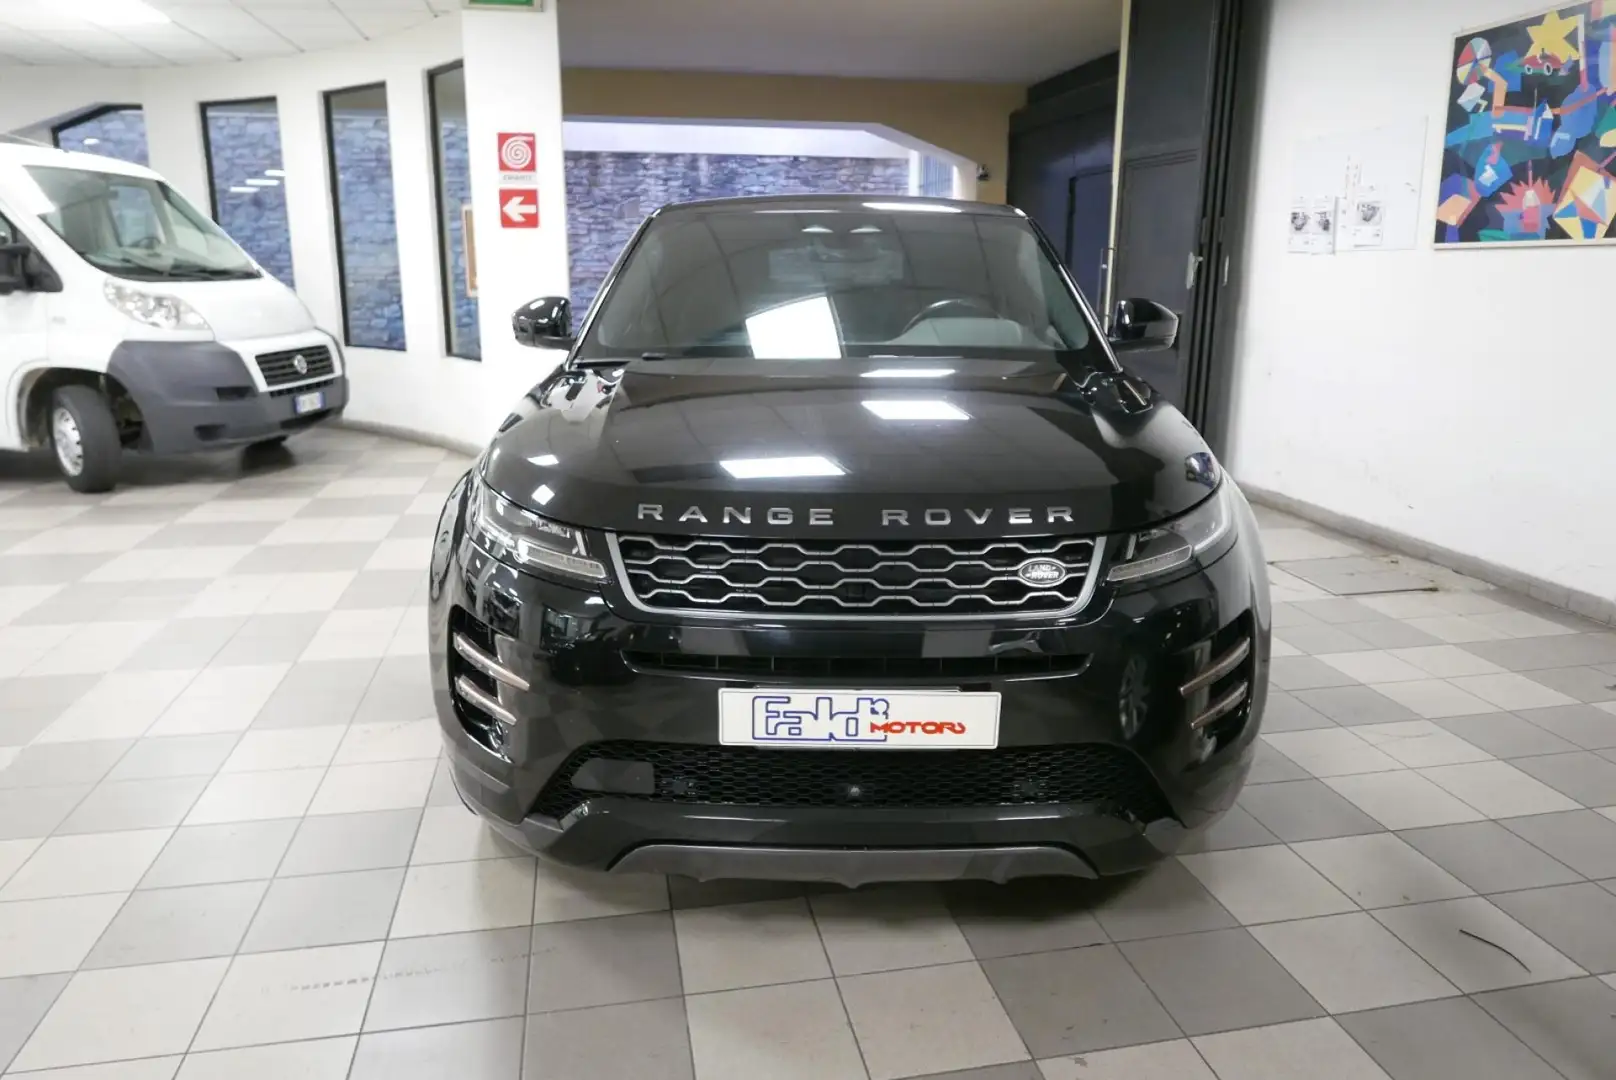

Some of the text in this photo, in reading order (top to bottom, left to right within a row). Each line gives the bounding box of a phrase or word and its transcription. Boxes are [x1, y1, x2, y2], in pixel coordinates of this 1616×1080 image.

[637, 501, 1075, 526] RANGE ROVER
[869, 721, 966, 735] MOTORS
